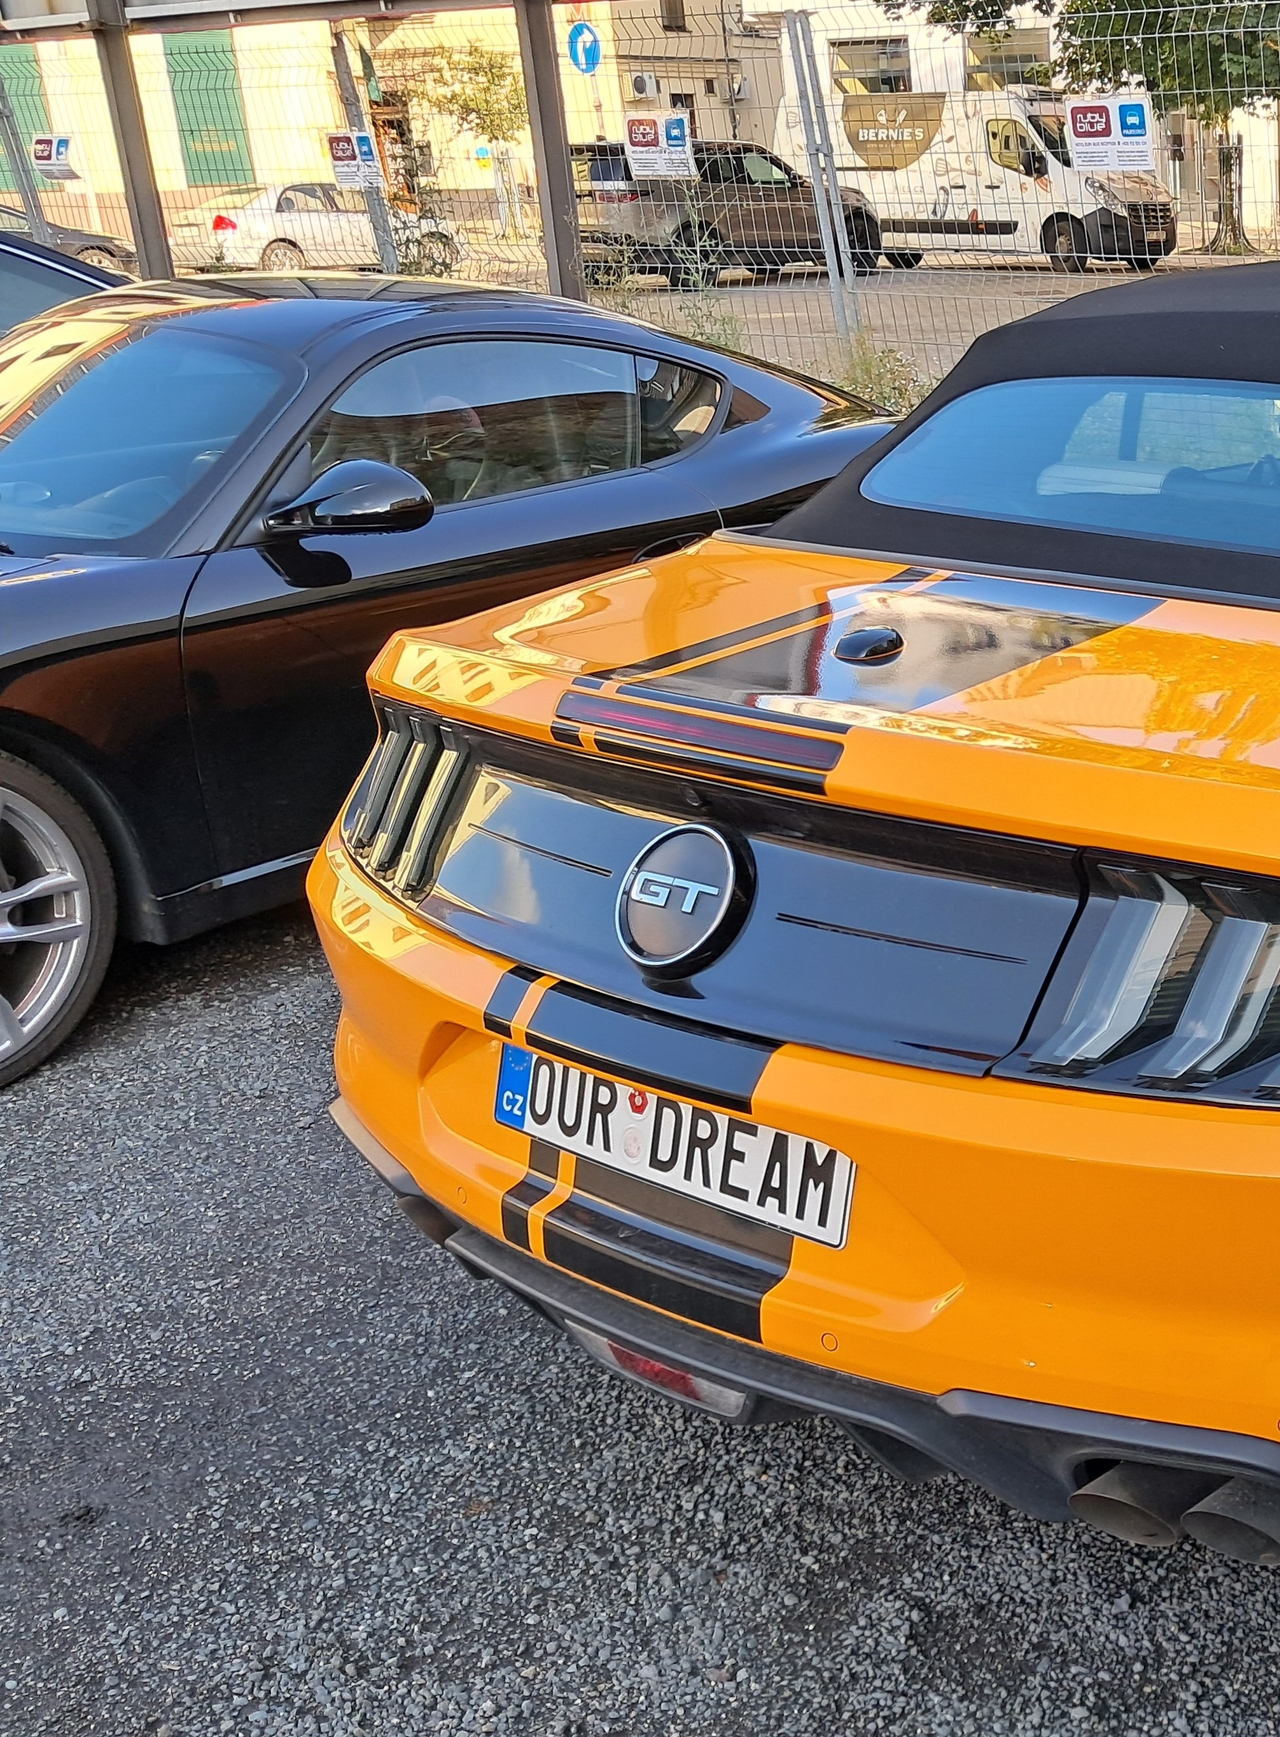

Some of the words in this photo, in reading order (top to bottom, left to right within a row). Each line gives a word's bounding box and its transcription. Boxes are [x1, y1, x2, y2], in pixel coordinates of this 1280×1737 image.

[1077, 112, 1106, 123] ruby
[1077, 121, 1105, 132] blue
[632, 133, 654, 141] blue
[858, 127, 925, 142] BERNIE'S
[630, 870, 720, 914] GT
[502, 1090, 523, 1116] CZ
[530, 1055, 618, 1154] OUR
[649, 1095, 838, 1229] DREAM
